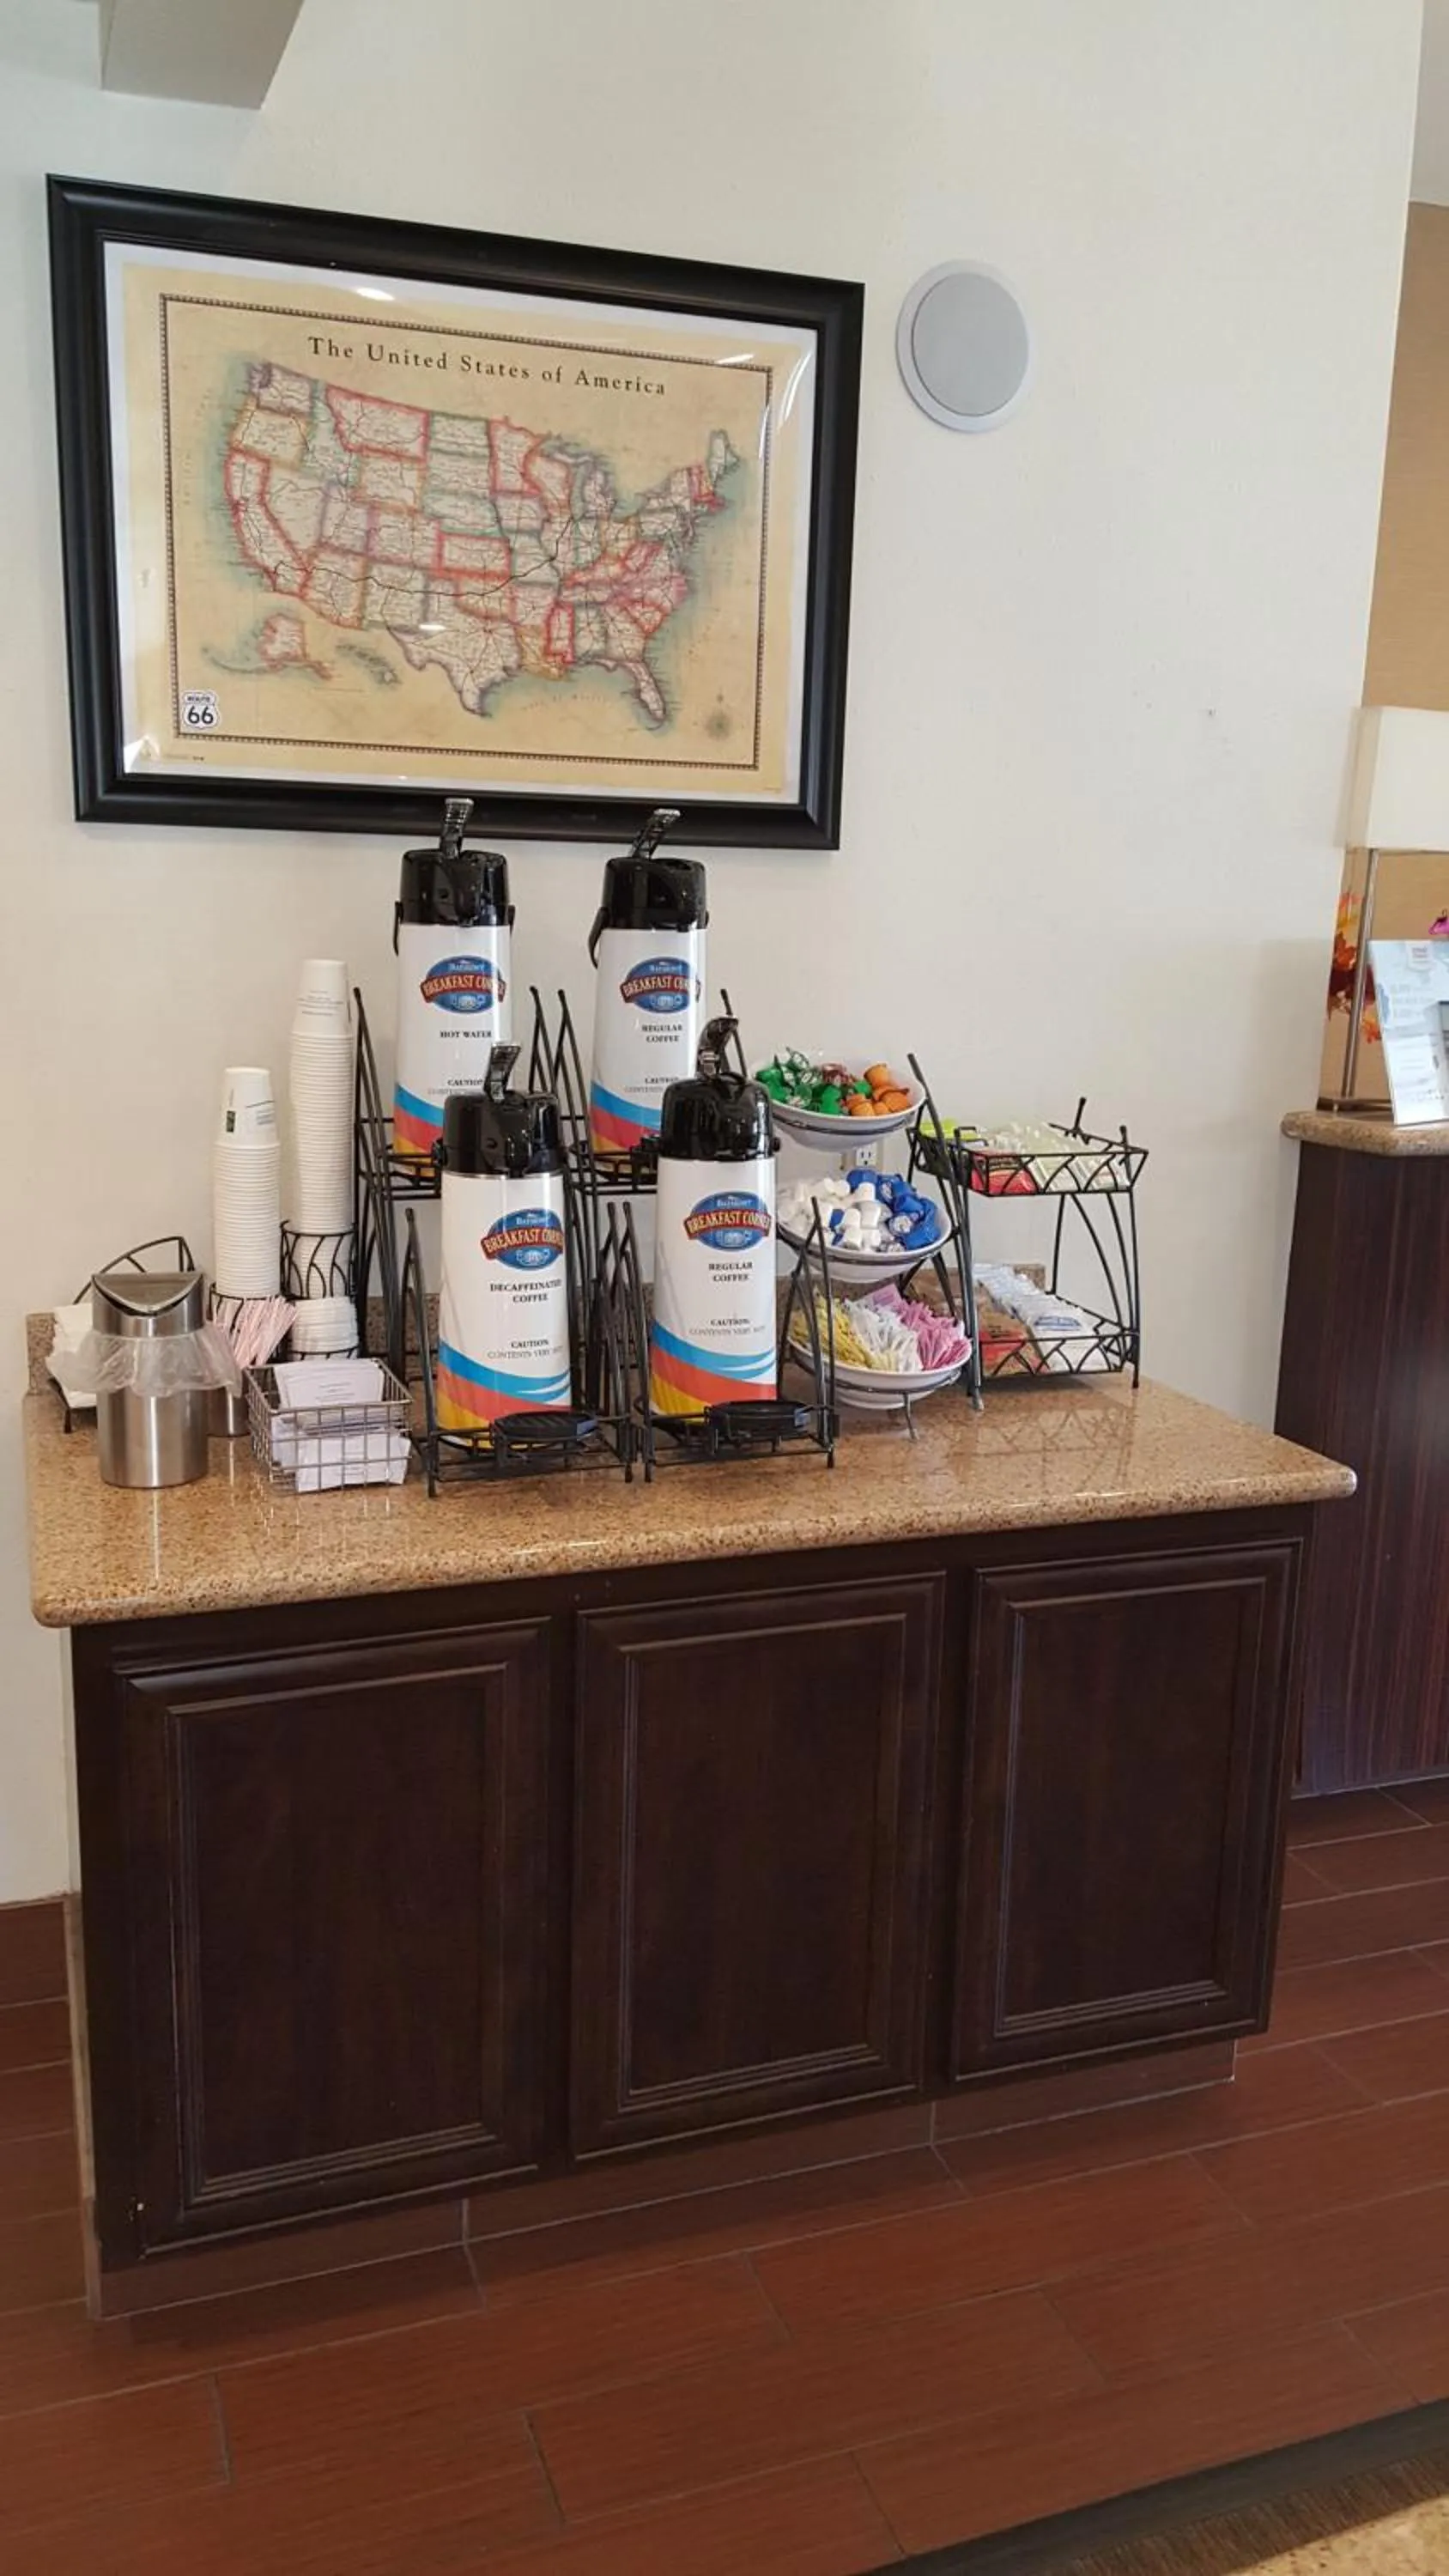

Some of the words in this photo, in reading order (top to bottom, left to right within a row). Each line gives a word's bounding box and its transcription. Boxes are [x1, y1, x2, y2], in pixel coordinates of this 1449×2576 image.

[308, 336, 354, 358] The
[367, 343, 448, 370] United
[460, 354, 530, 380] States
[542, 365, 563, 383] of
[574, 368, 665, 396] America
[187, 705, 214, 725] 66
[421, 974, 475, 997] BREAKFAST
[622, 974, 672, 998] BREAKFAST
[687, 1209, 741, 1235] BREAKFAST
[483, 1228, 540, 1254] BREAKFAST
[708, 1261, 753, 1271] REGULAR
[489, 1279, 562, 1292] DECAFFEINATED
[713, 1273, 749, 1282] COFFEE
[512, 1293, 549, 1303] COFFEE
[511, 1339, 549, 1348] CAUTION
